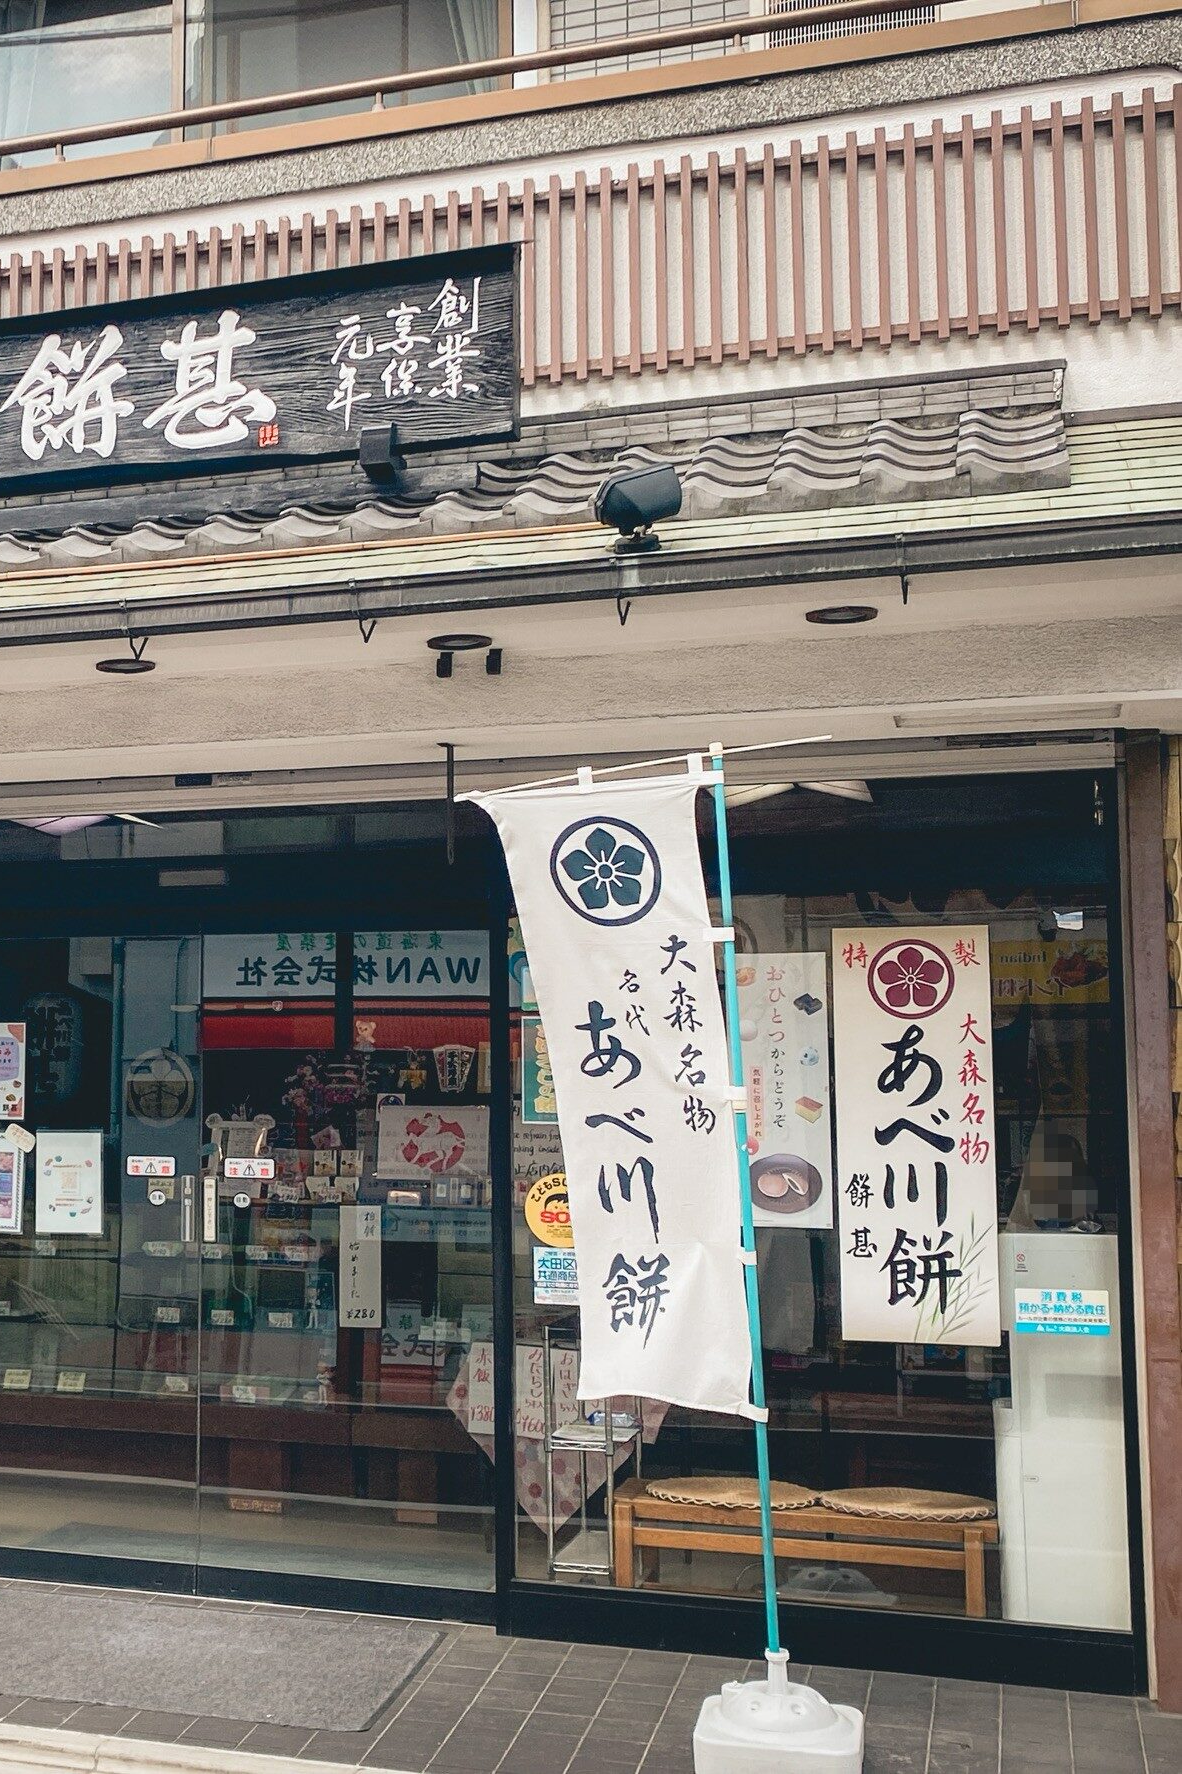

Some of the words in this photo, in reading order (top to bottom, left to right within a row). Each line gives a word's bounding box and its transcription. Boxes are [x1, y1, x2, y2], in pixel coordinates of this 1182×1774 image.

[326, 315, 375, 431] 元年
[378, 303, 430, 398] 享保
[428, 277, 481, 399] 創業
[618, 968, 650, 1036] 名代
[659, 934, 717, 1135] 大森名物
[767, 965, 786, 1128] おひとつからどうぞ
[958, 1012, 990, 1165] 大森名物
[574, 1000, 671, 1350] あべ川餅
[845, 1172, 878, 1259] 餅甚
[874, 1024, 962, 1315] あべ川餅
[537, 1256, 578, 1271] 大田区
[1041, 1290, 1082, 1303] 消費税
[346, 1308, 376, 1320] ¥280
[473, 1347, 492, 1384] 赤飯
[559, 1352, 577, 1399] おはぎ
